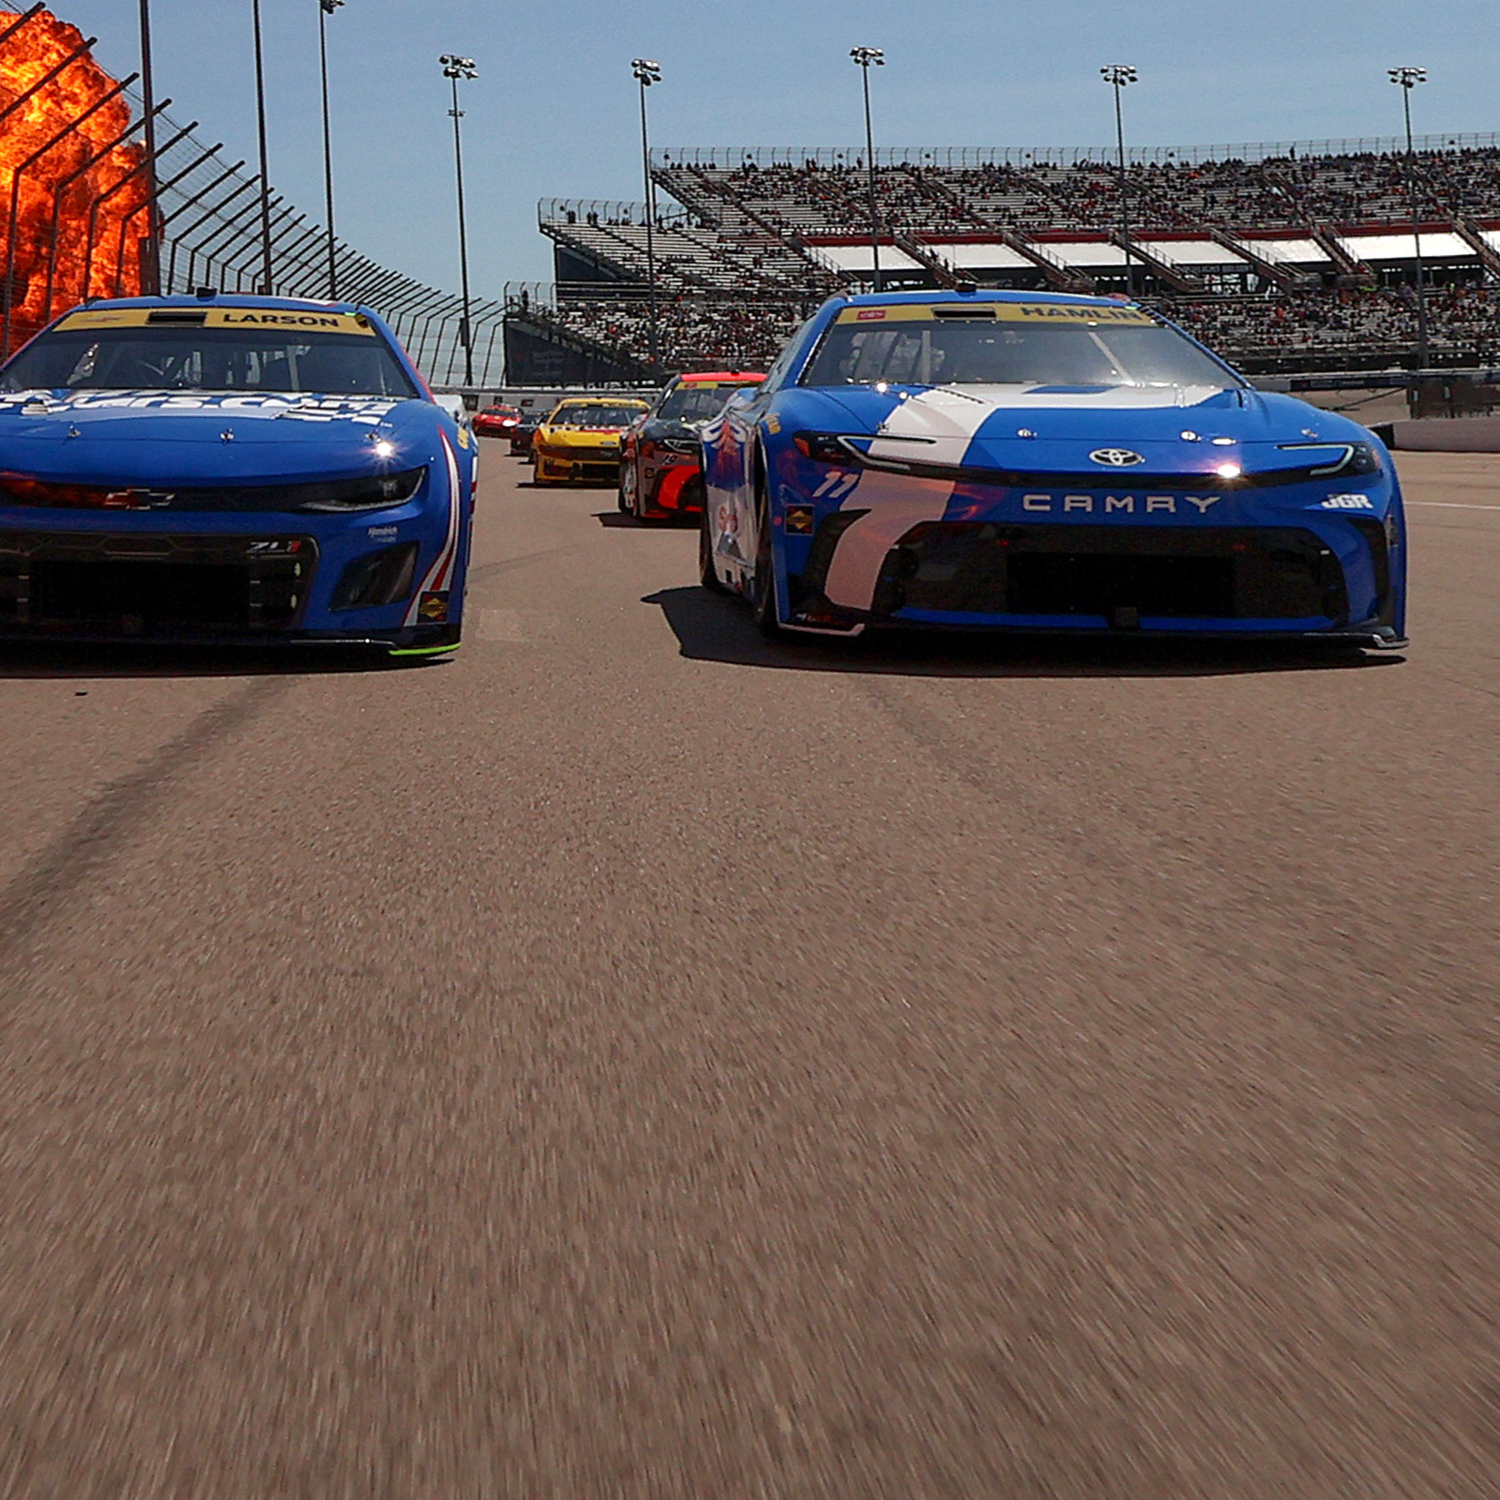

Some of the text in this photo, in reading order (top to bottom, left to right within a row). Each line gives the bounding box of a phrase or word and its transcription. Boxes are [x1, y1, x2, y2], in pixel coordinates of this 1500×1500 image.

[223, 314, 339, 327] LARSON
[1021, 307, 1142, 320] HAMLIN
[812, 470, 859, 498] 11
[1023, 494, 1221, 513] CAMRY
[1321, 494, 1374, 509] JGR
